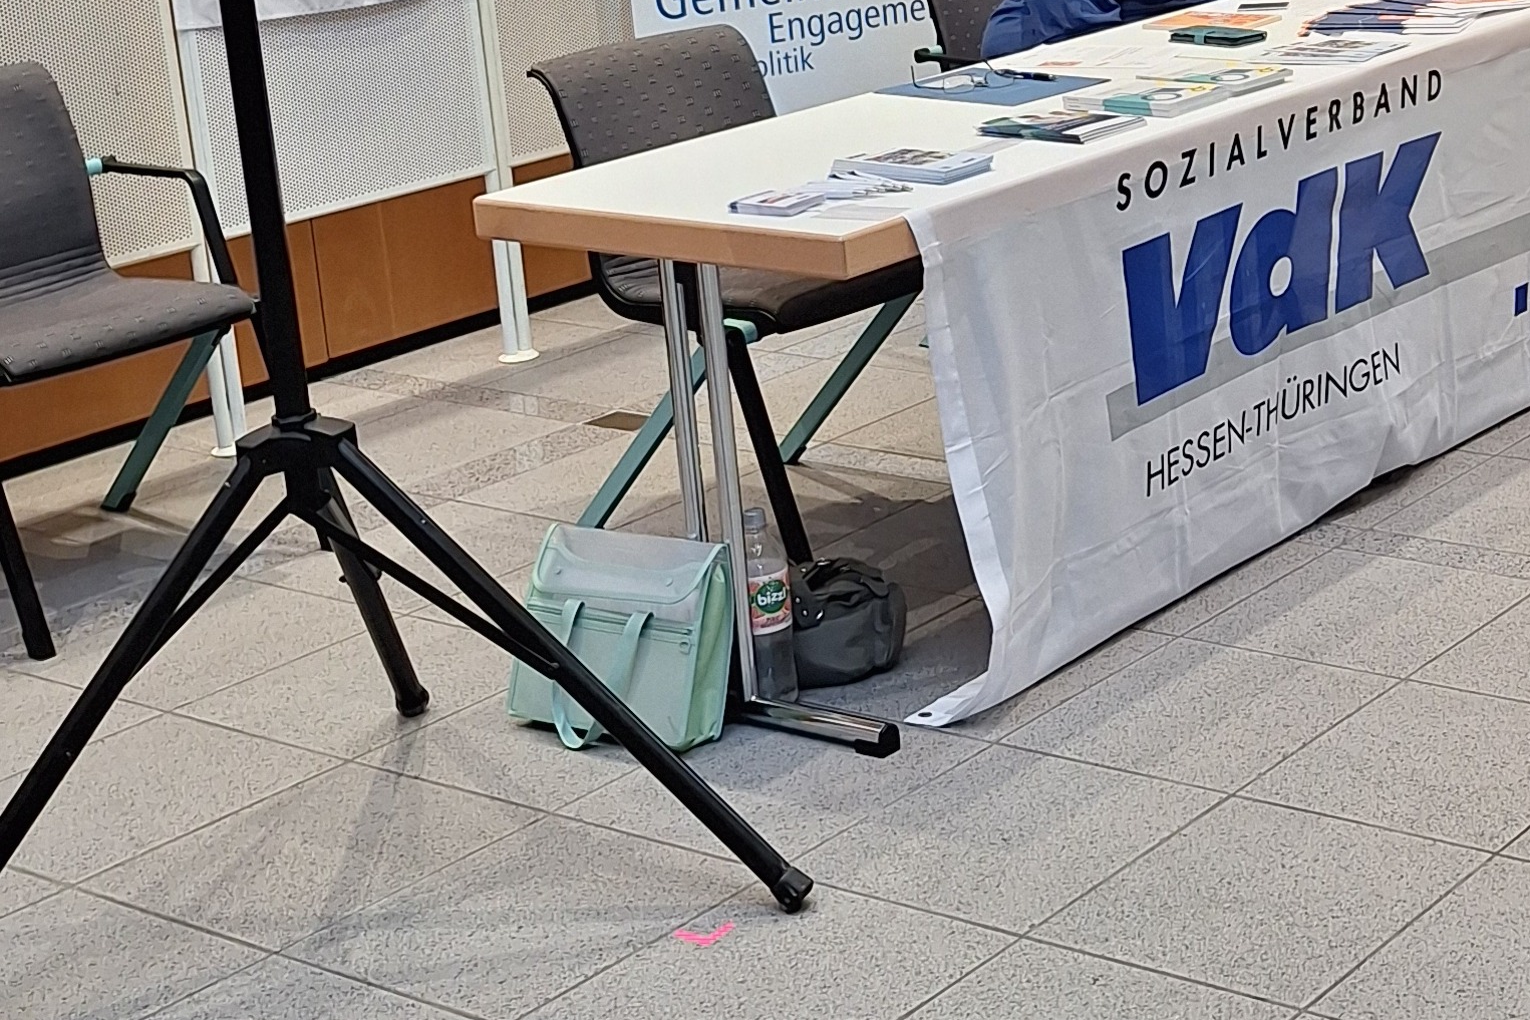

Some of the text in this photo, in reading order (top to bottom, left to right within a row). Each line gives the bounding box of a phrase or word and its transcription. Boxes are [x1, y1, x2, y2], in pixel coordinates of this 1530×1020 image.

[757, 46, 814, 78] olitik
[1114, 68, 1444, 212] SOZIALVERBAND
[1122, 131, 1442, 407] VdK
[1145, 342, 1402, 498] HESSEN-THÜRINGEN
